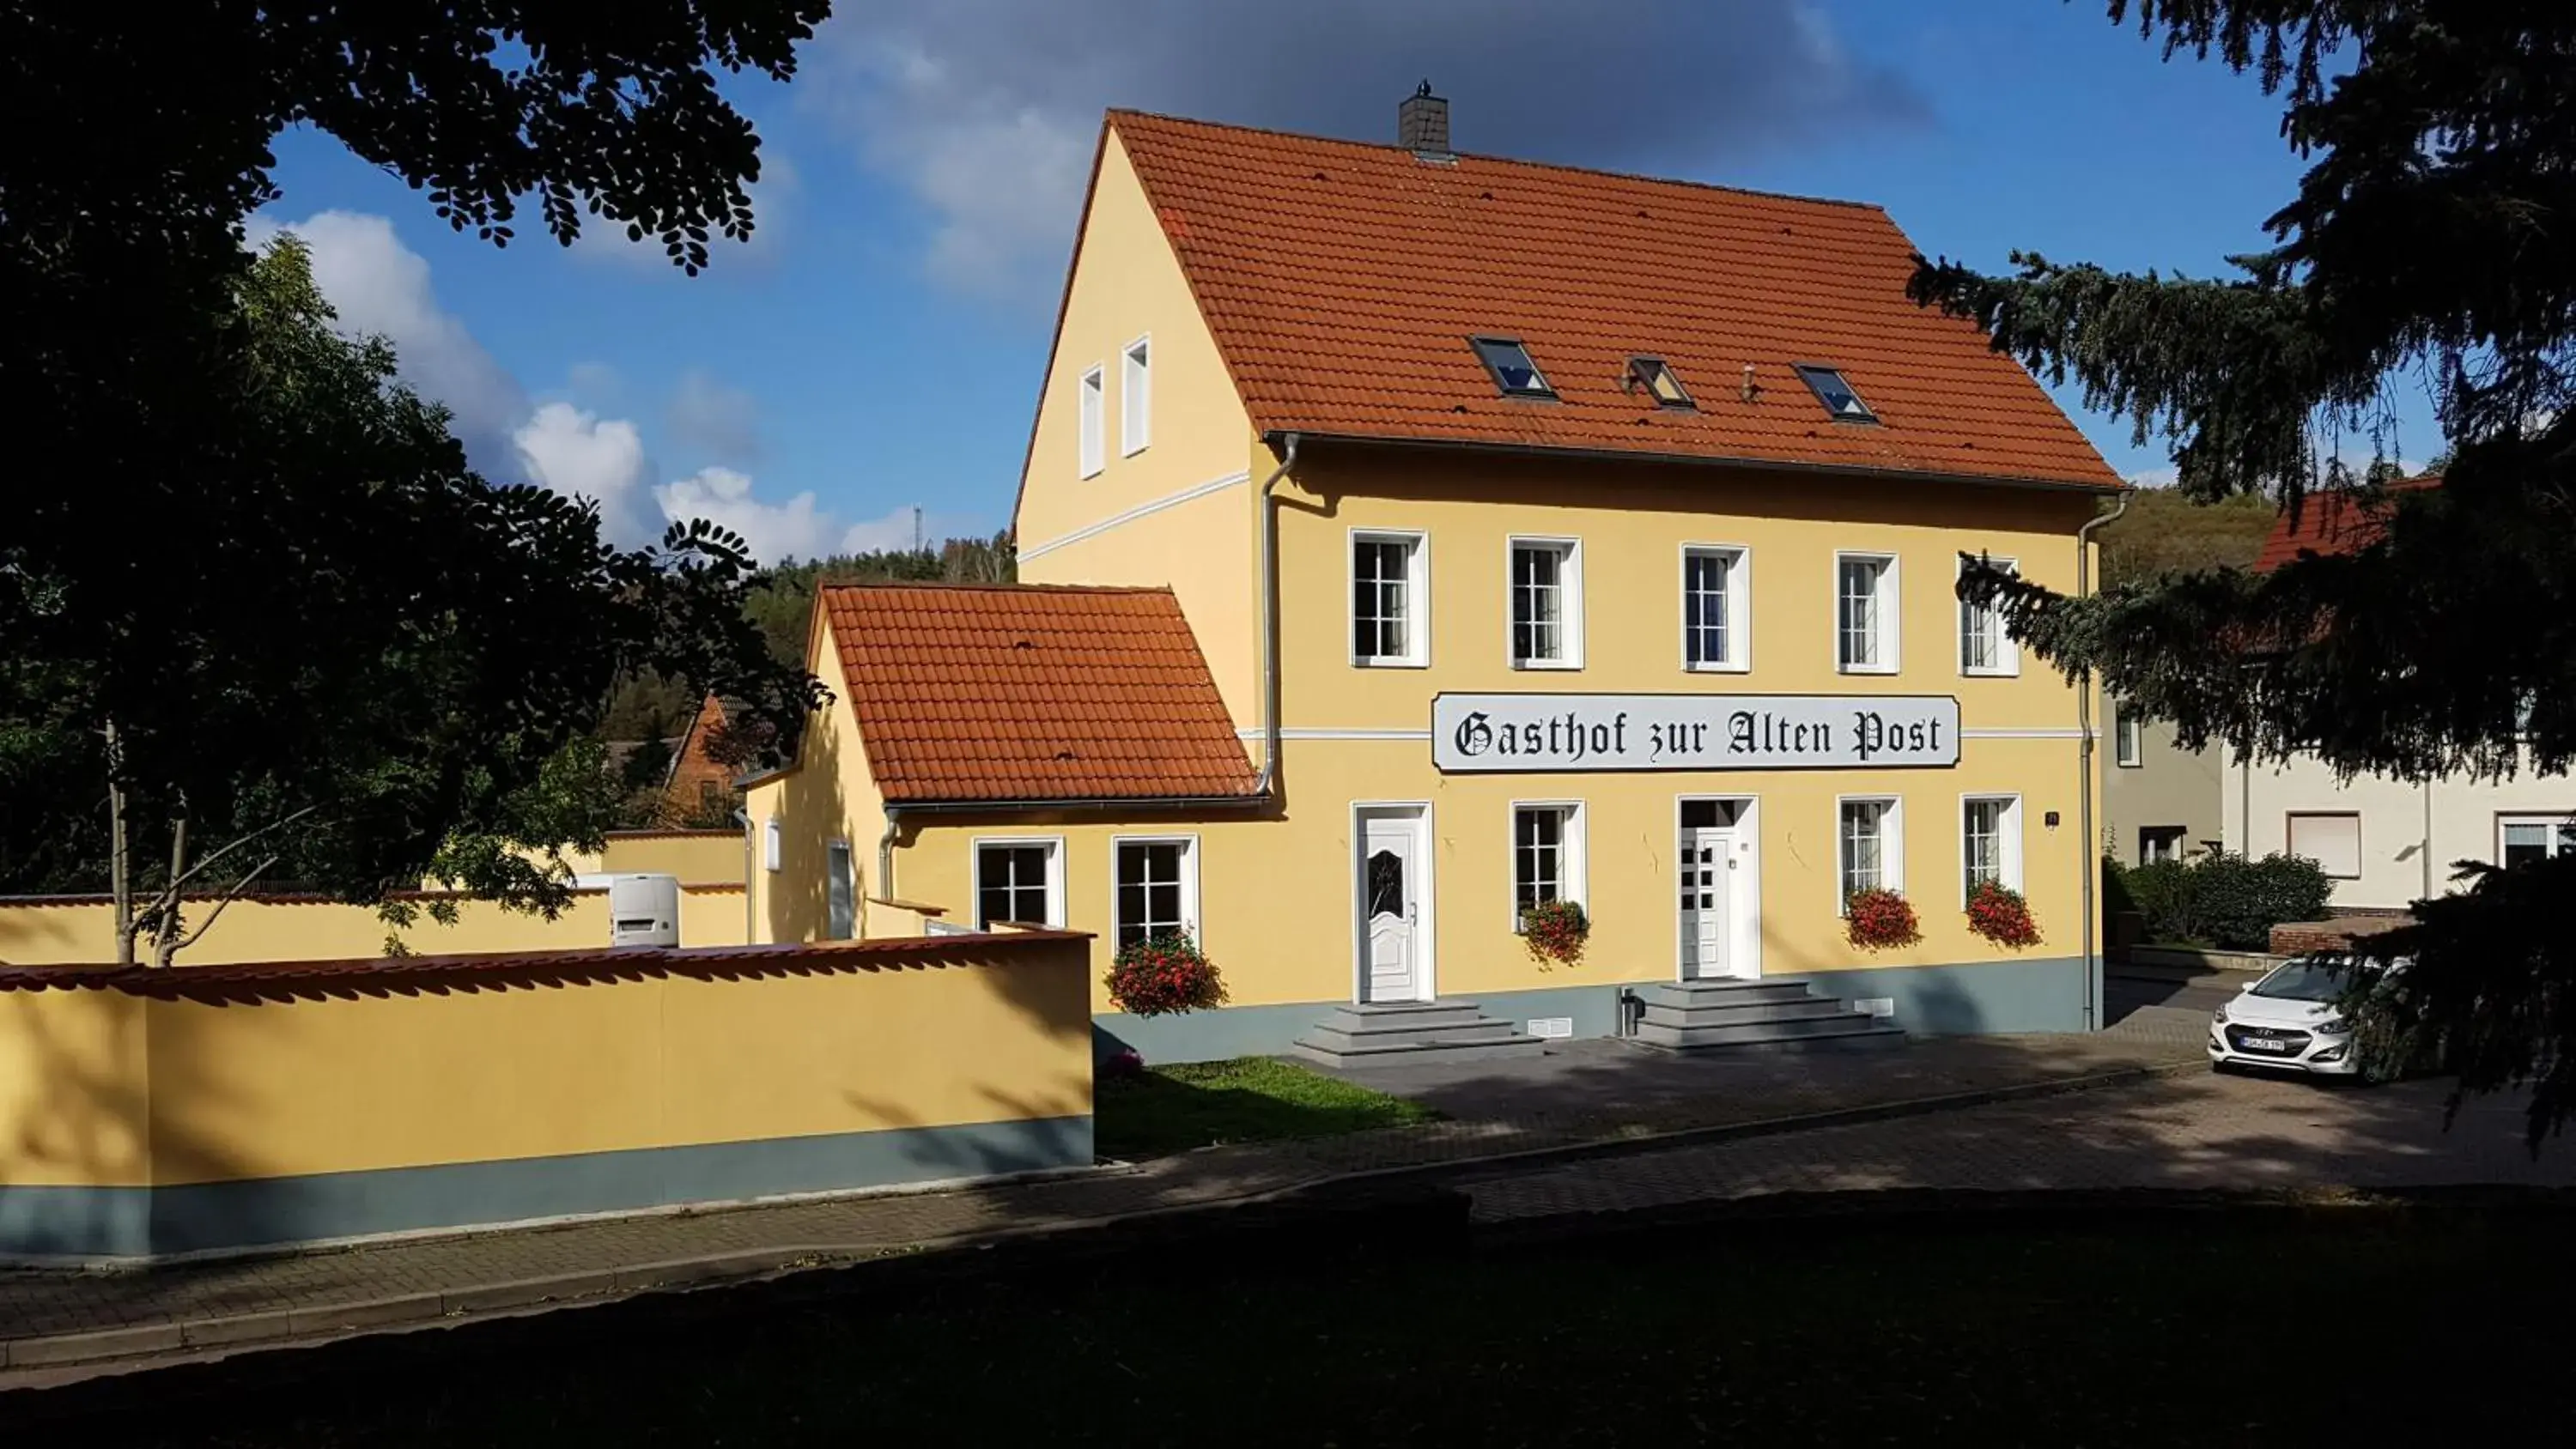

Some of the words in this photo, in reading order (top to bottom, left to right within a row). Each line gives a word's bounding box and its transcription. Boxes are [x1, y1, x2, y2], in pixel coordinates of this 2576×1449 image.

[1455, 711, 1627, 761] Gasthof
[1649, 722, 1708, 763] zur
[1727, 711, 1832, 754] Alten
[1852, 711, 1941, 761] Post
